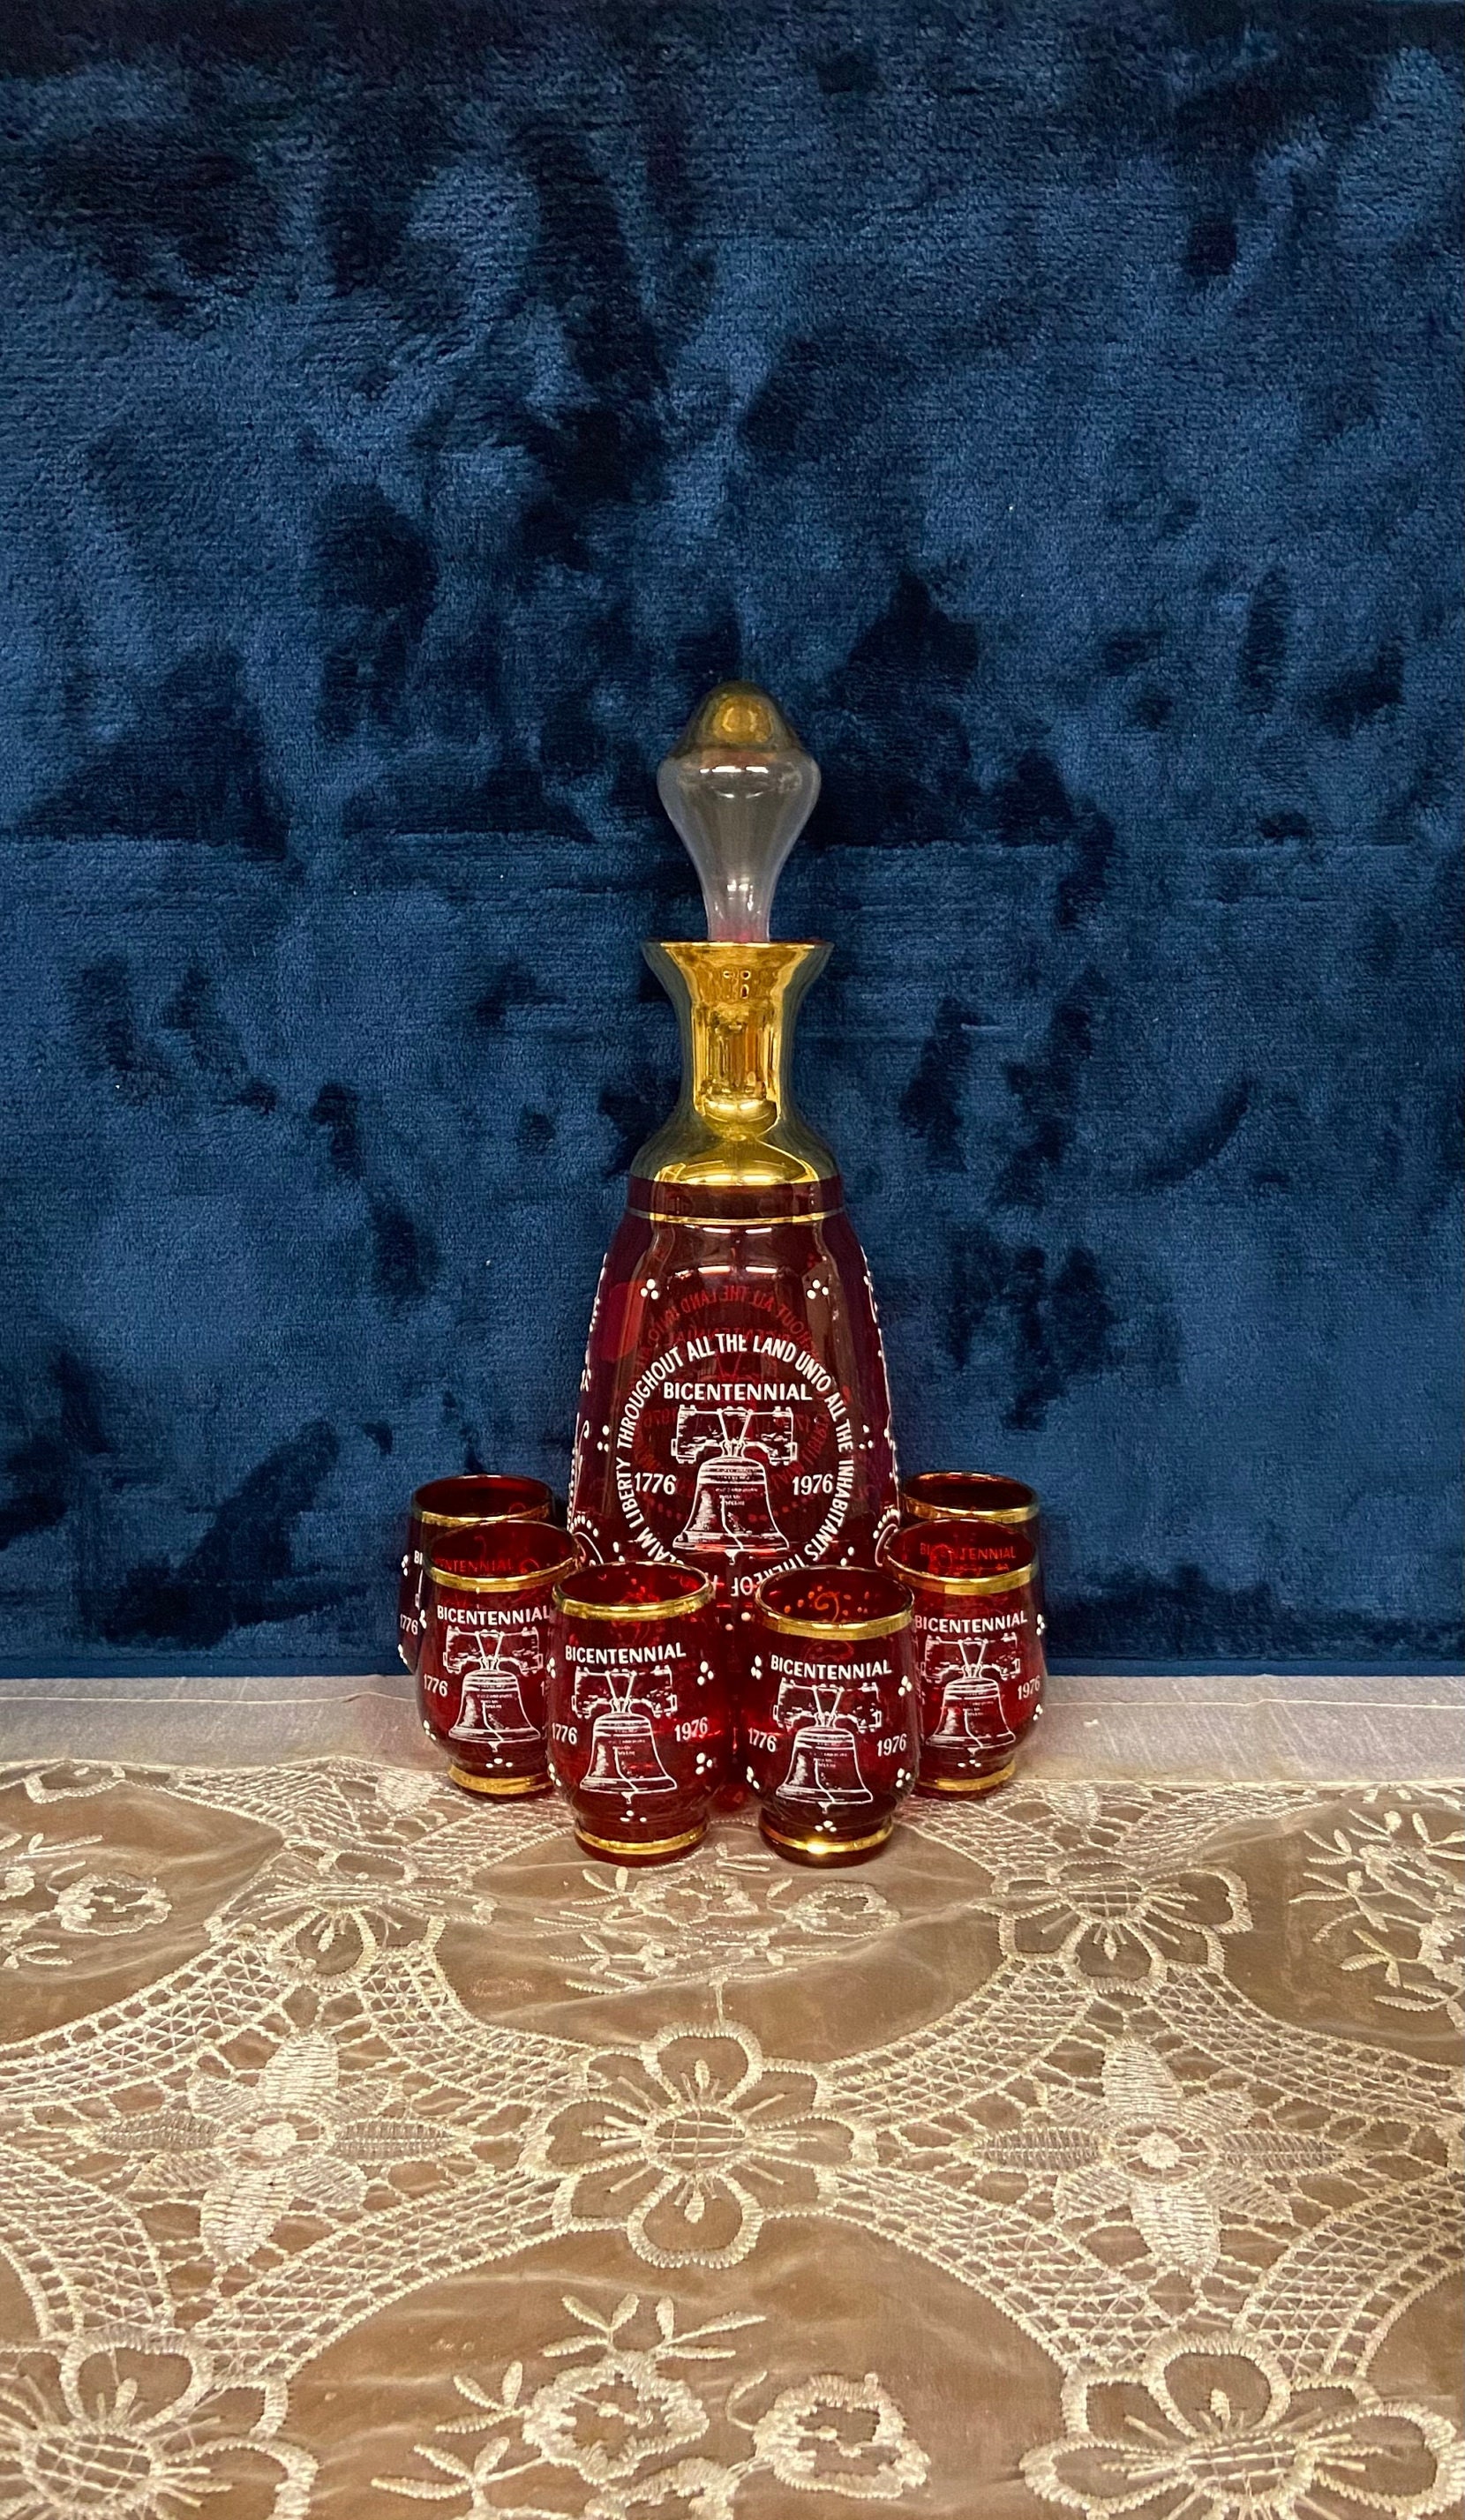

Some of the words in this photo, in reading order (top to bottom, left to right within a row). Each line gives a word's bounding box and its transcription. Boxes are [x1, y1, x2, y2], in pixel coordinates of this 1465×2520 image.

[687, 1336, 716, 1361] ALL
[715, 1333, 747, 1352] THE
[753, 1335, 796, 1362] LAND
[794, 1351, 831, 1391] UNTO
[617, 1346, 684, 1448] THROUGHOUT
[664, 1382, 813, 1401] BICENTENNIAL
[824, 1392, 848, 1423] ALL
[834, 1418, 853, 1451] THE
[616, 1457, 644, 1528] LIBERTY
[634, 1472, 677, 1495] 1776
[793, 1474, 833, 1495] 1976
[804, 1459, 854, 1562] INHABITANTS
[437, 1605, 551, 1626] BICENTENNIAL
[914, 1610, 1028, 1634] BICENTENNIAL
[565, 1642, 687, 1665] BICENTENNIAL
[770, 1654, 892, 1681] BICENTENNIAL
[424, 1674, 448, 1698] 1776
[1018, 1676, 1041, 1700] 1976
[552, 1722, 578, 1745] 1776
[674, 1716, 709, 1743] 1976
[748, 1728, 777, 1753] 1776
[876, 1734, 907, 1758] 1976
